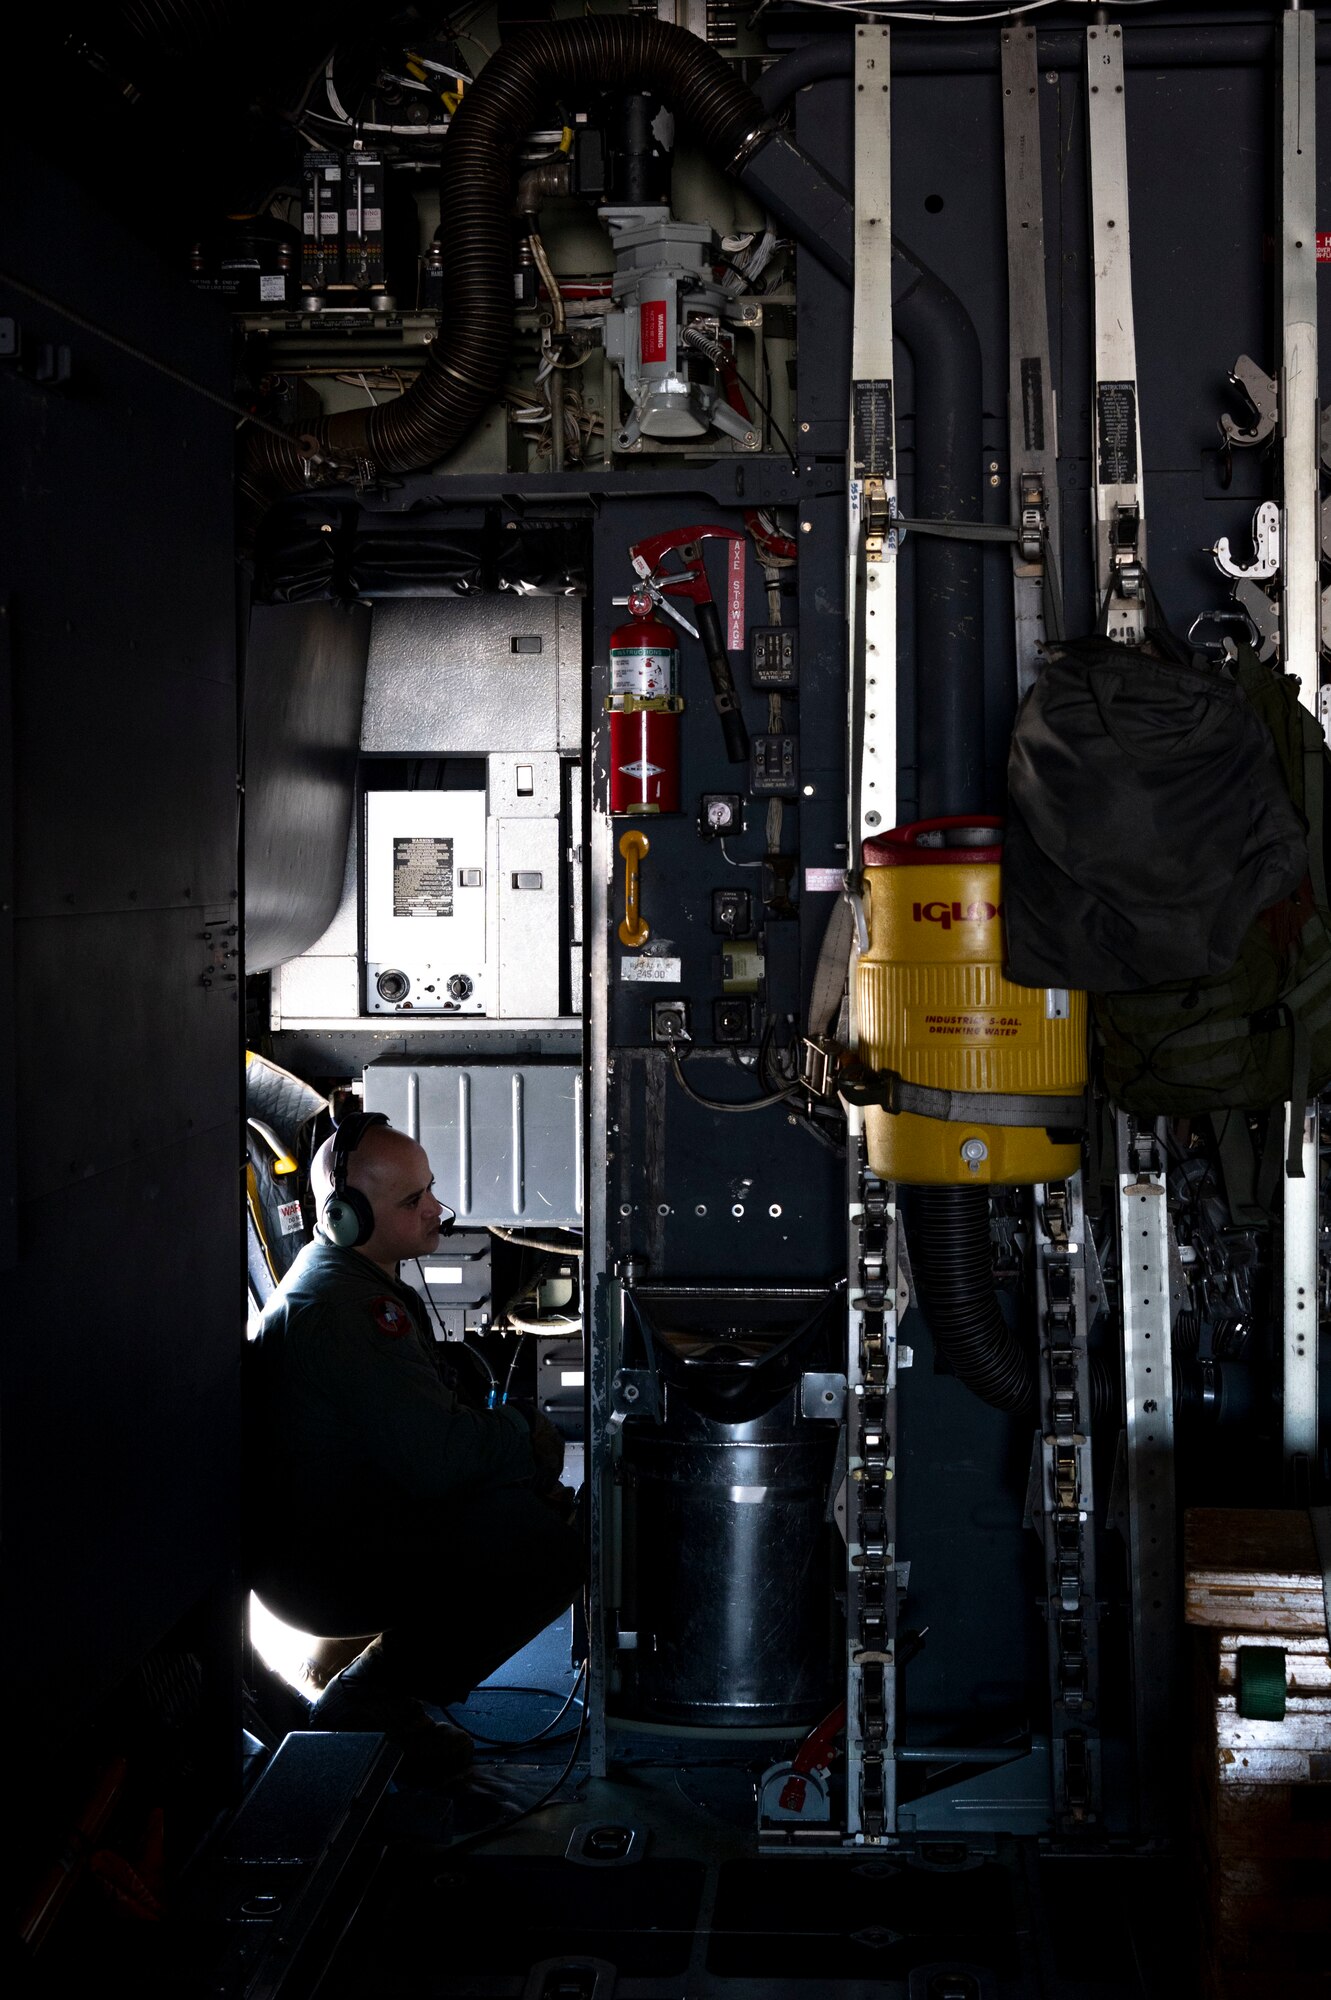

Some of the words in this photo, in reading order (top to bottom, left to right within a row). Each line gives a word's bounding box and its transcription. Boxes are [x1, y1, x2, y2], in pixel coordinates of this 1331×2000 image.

[1099, 383, 1132, 391] INSTRUCTIONS
[733, 540, 741, 570] AXE
[732, 581, 741, 650] STOWAGE
[989, 1017, 1022, 1026] 5-GAL.
[929, 1026, 981, 1035] DRINKING
[985, 1027, 1018, 1037] WATER
